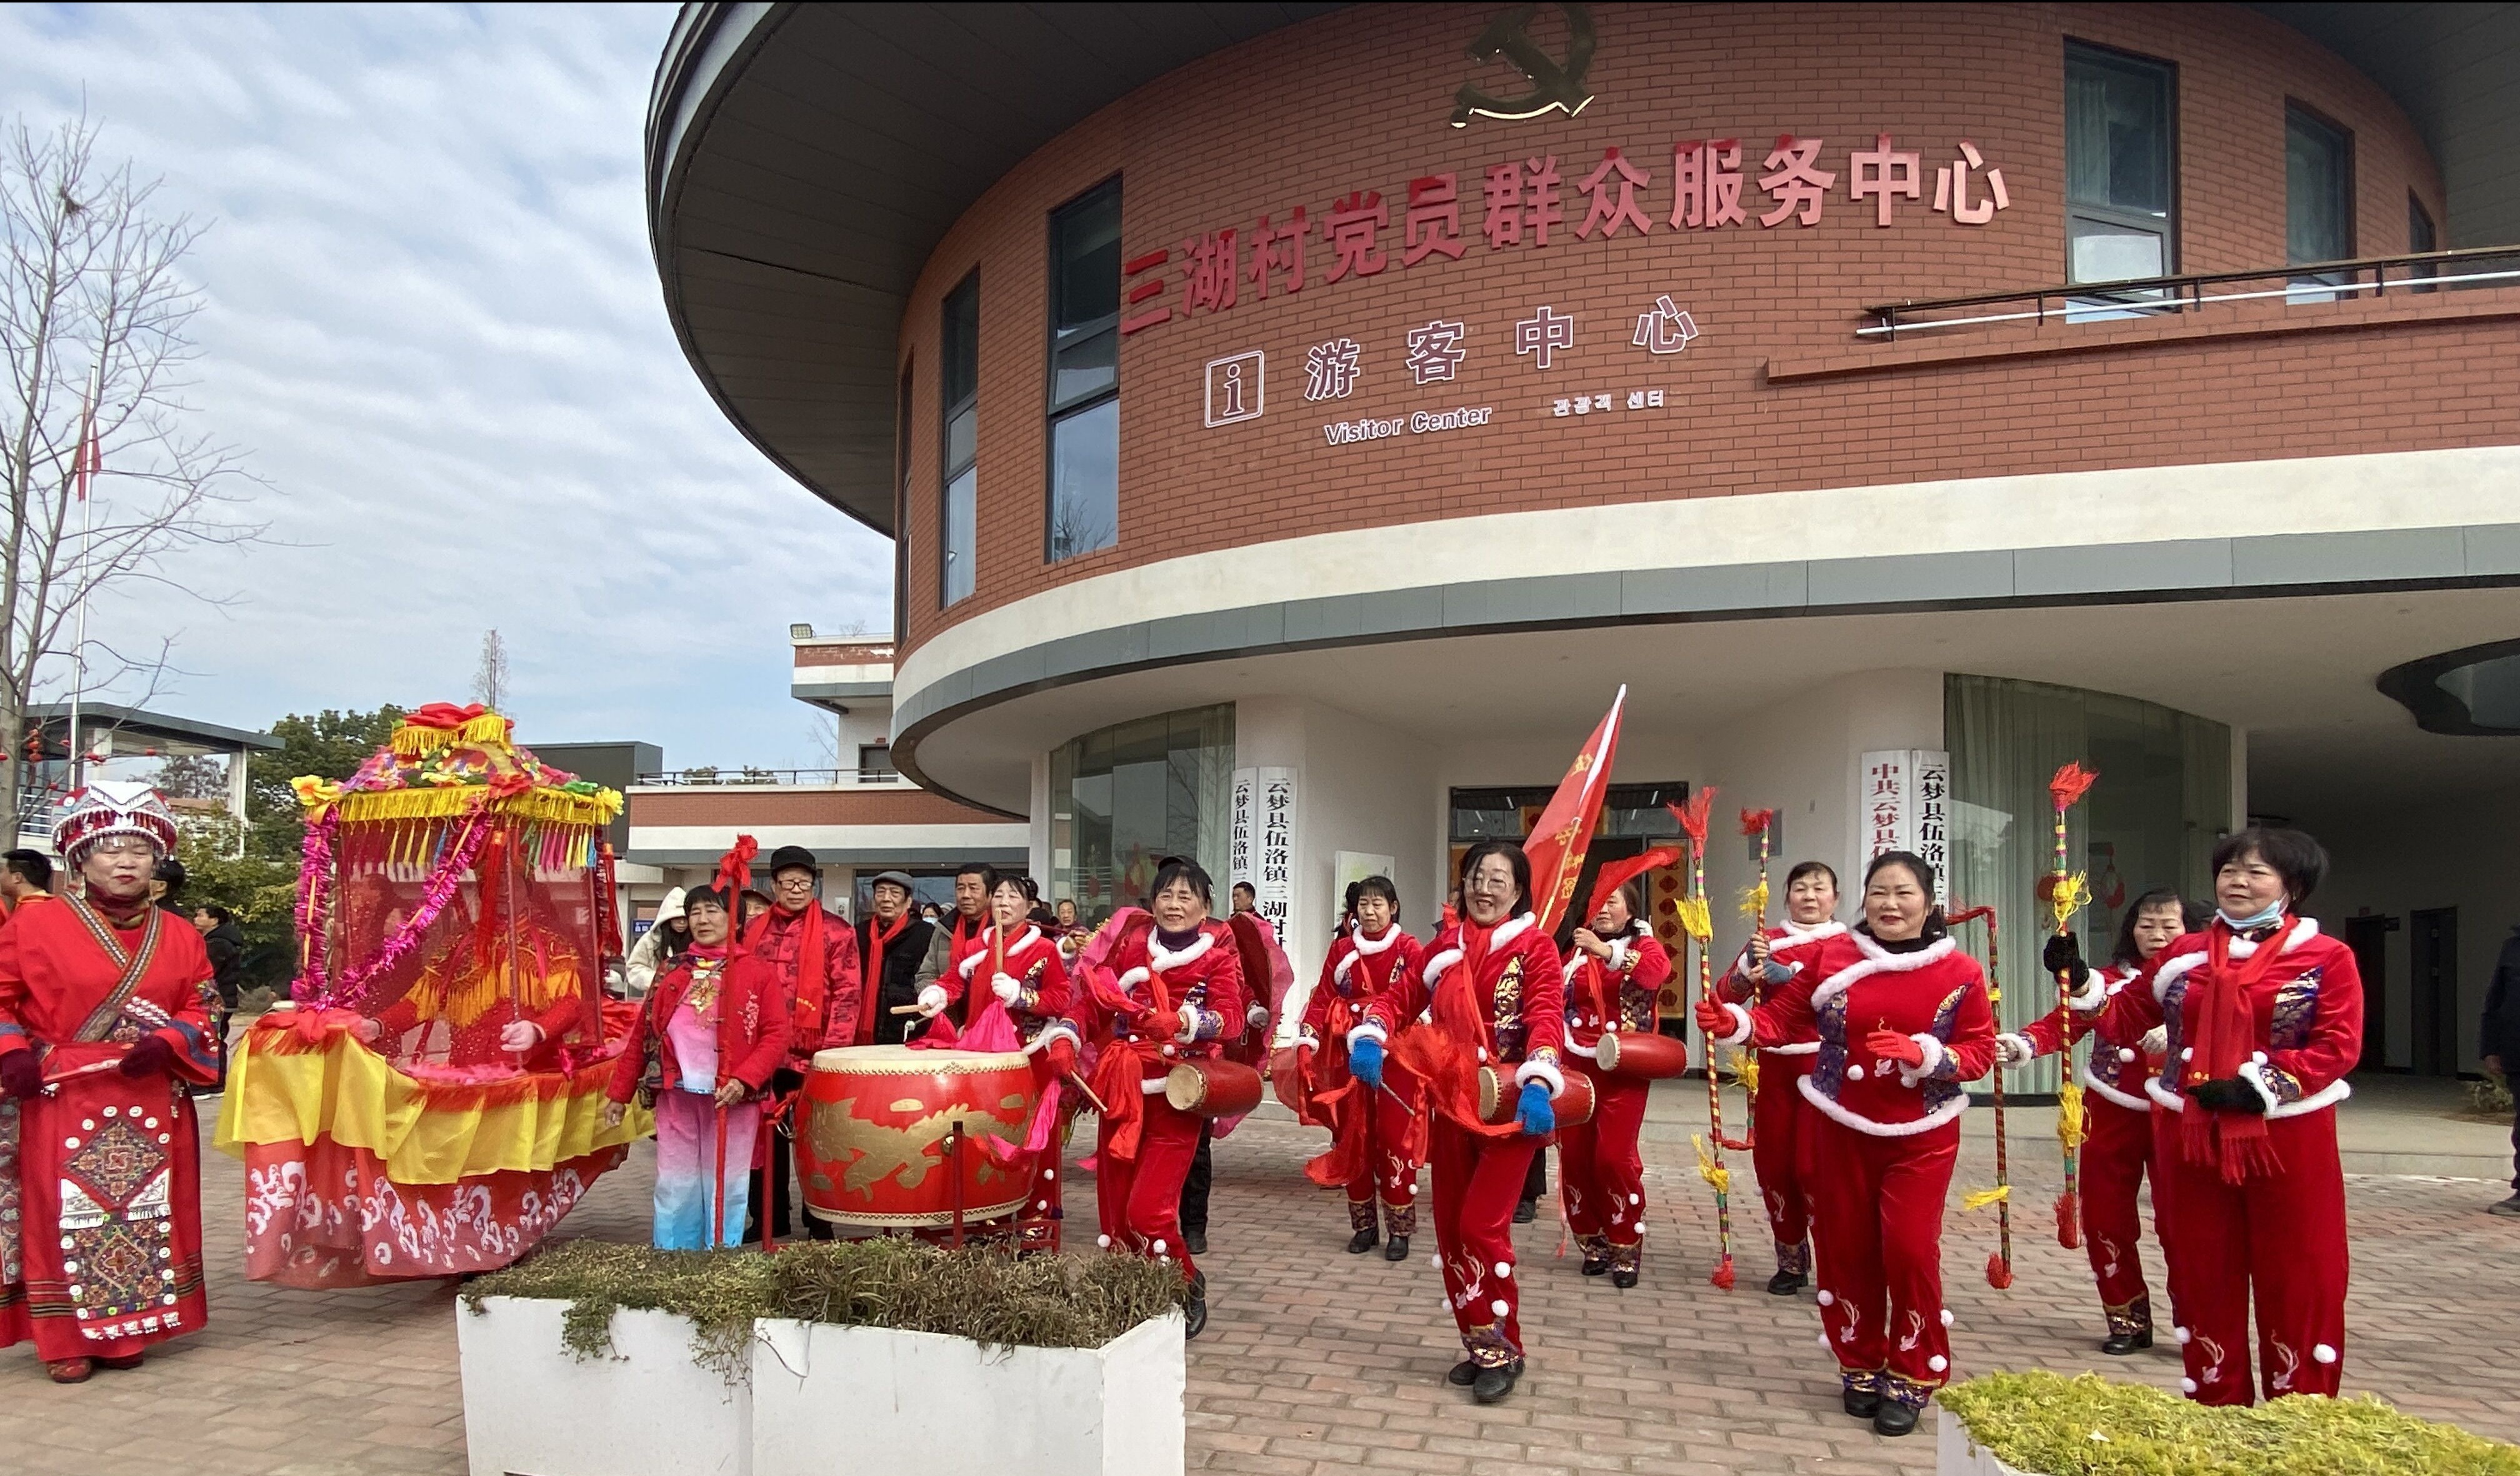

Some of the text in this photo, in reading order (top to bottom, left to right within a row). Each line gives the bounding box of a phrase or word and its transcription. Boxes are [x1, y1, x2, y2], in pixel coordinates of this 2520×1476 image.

[1119, 132, 2010, 334] 三湖村党员群众服务中心
[1304, 295, 1699, 401] 游客中心
[1324, 406, 1492, 446] Visitor Center
[1553, 389, 1664, 417] 관광객 센터
[1262, 777, 1291, 948] 云梦县伍洛镇三湖村
